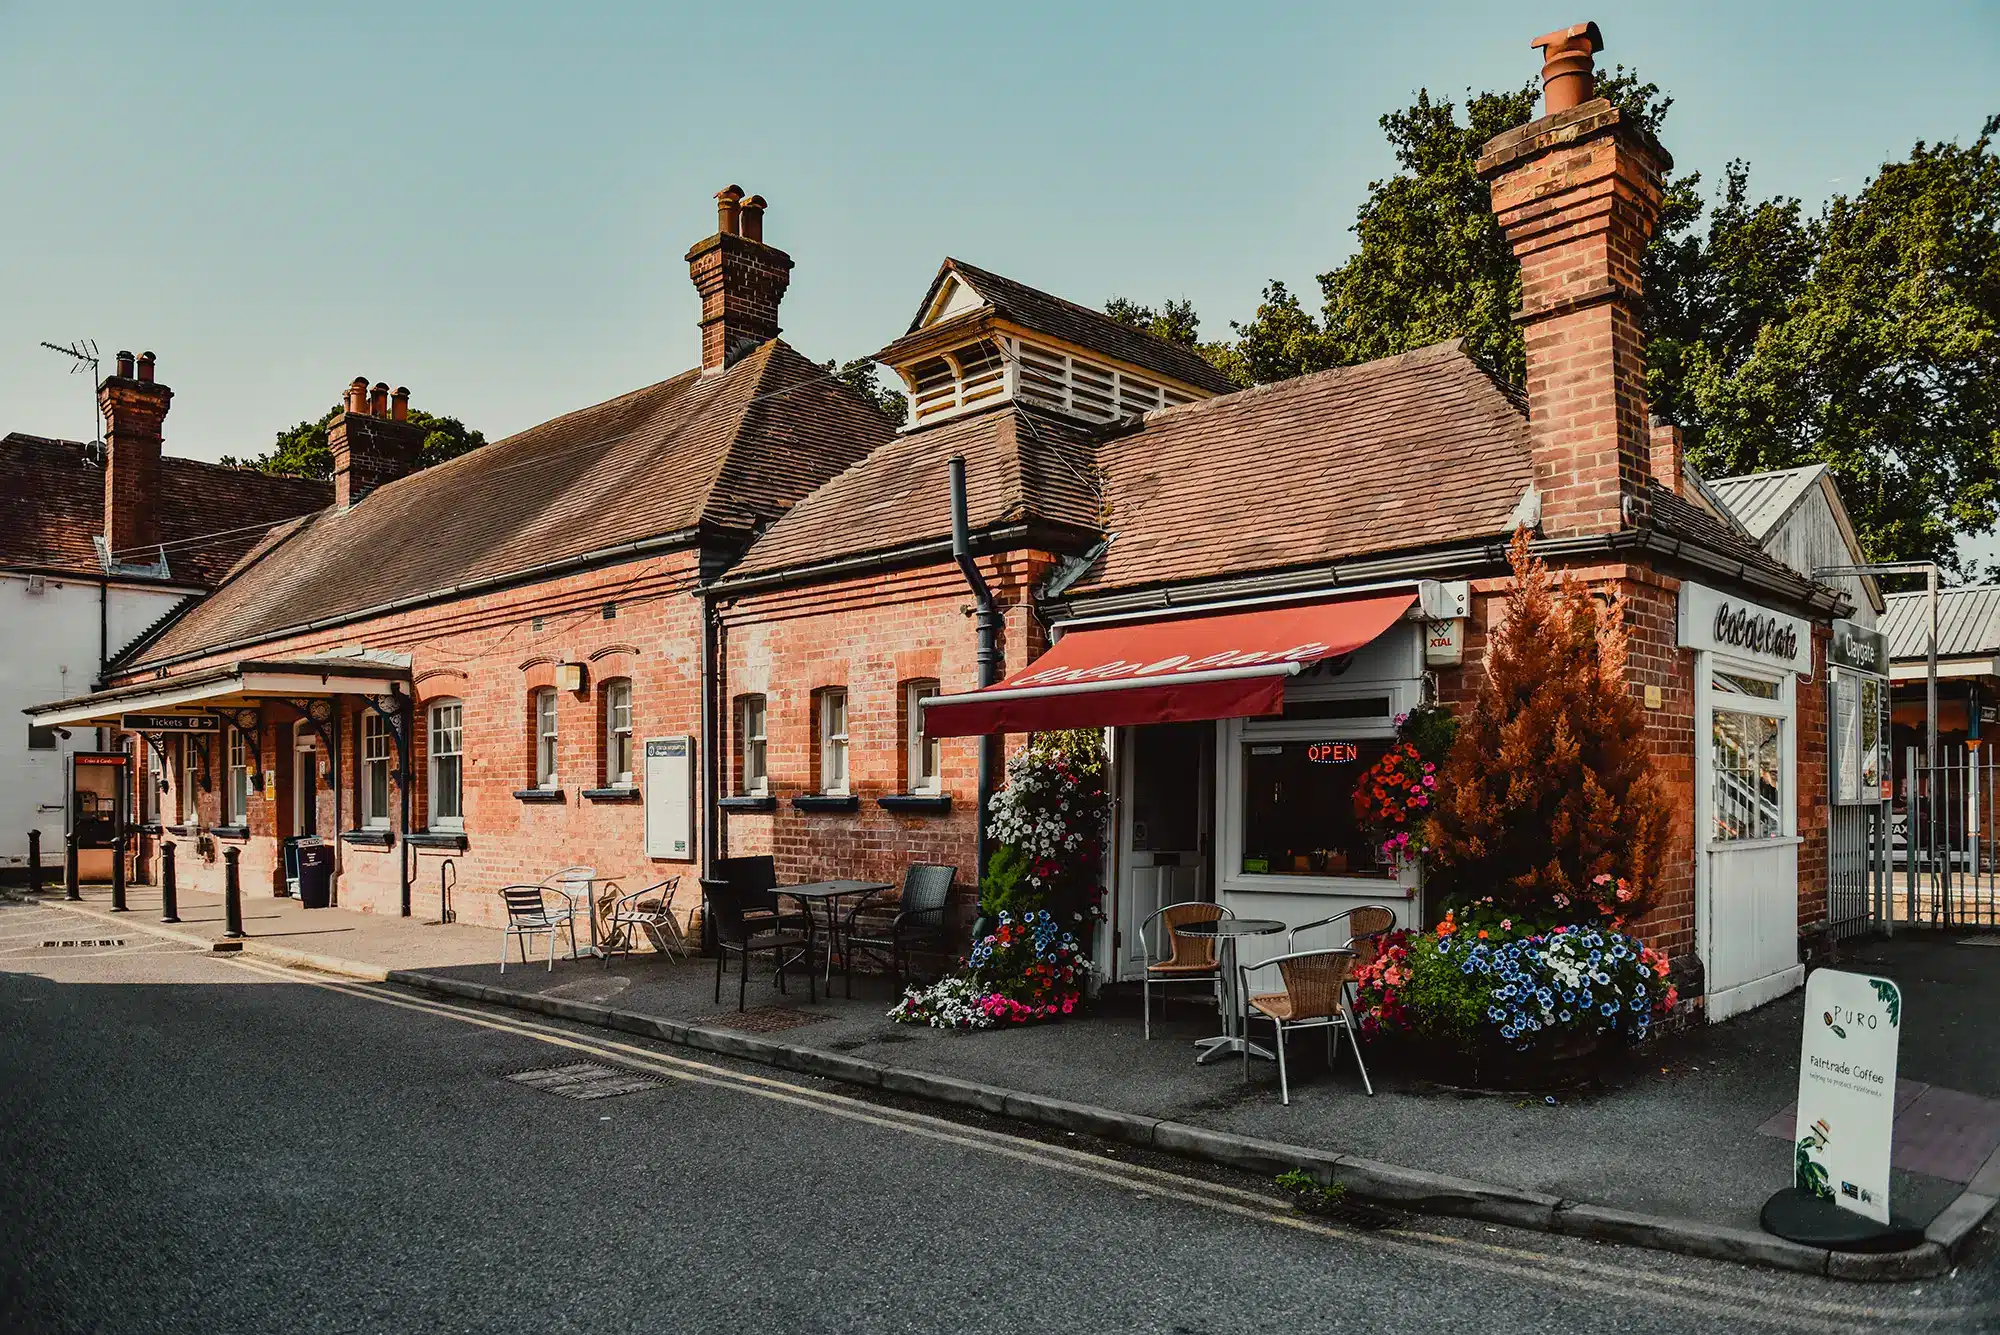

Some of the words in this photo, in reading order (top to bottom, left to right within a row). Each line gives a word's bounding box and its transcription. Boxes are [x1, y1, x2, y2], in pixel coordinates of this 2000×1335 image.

[1430, 638, 1452, 647] XTAL
[1845, 632, 1875, 666] Claygate
[149, 717, 183, 727] Tickets
[1308, 745, 1357, 760] OPEN
[1834, 1005, 1877, 1029] PURO
[1810, 1055, 1850, 1075] Fairtrade
[1853, 1065, 1884, 1084] Coffee
